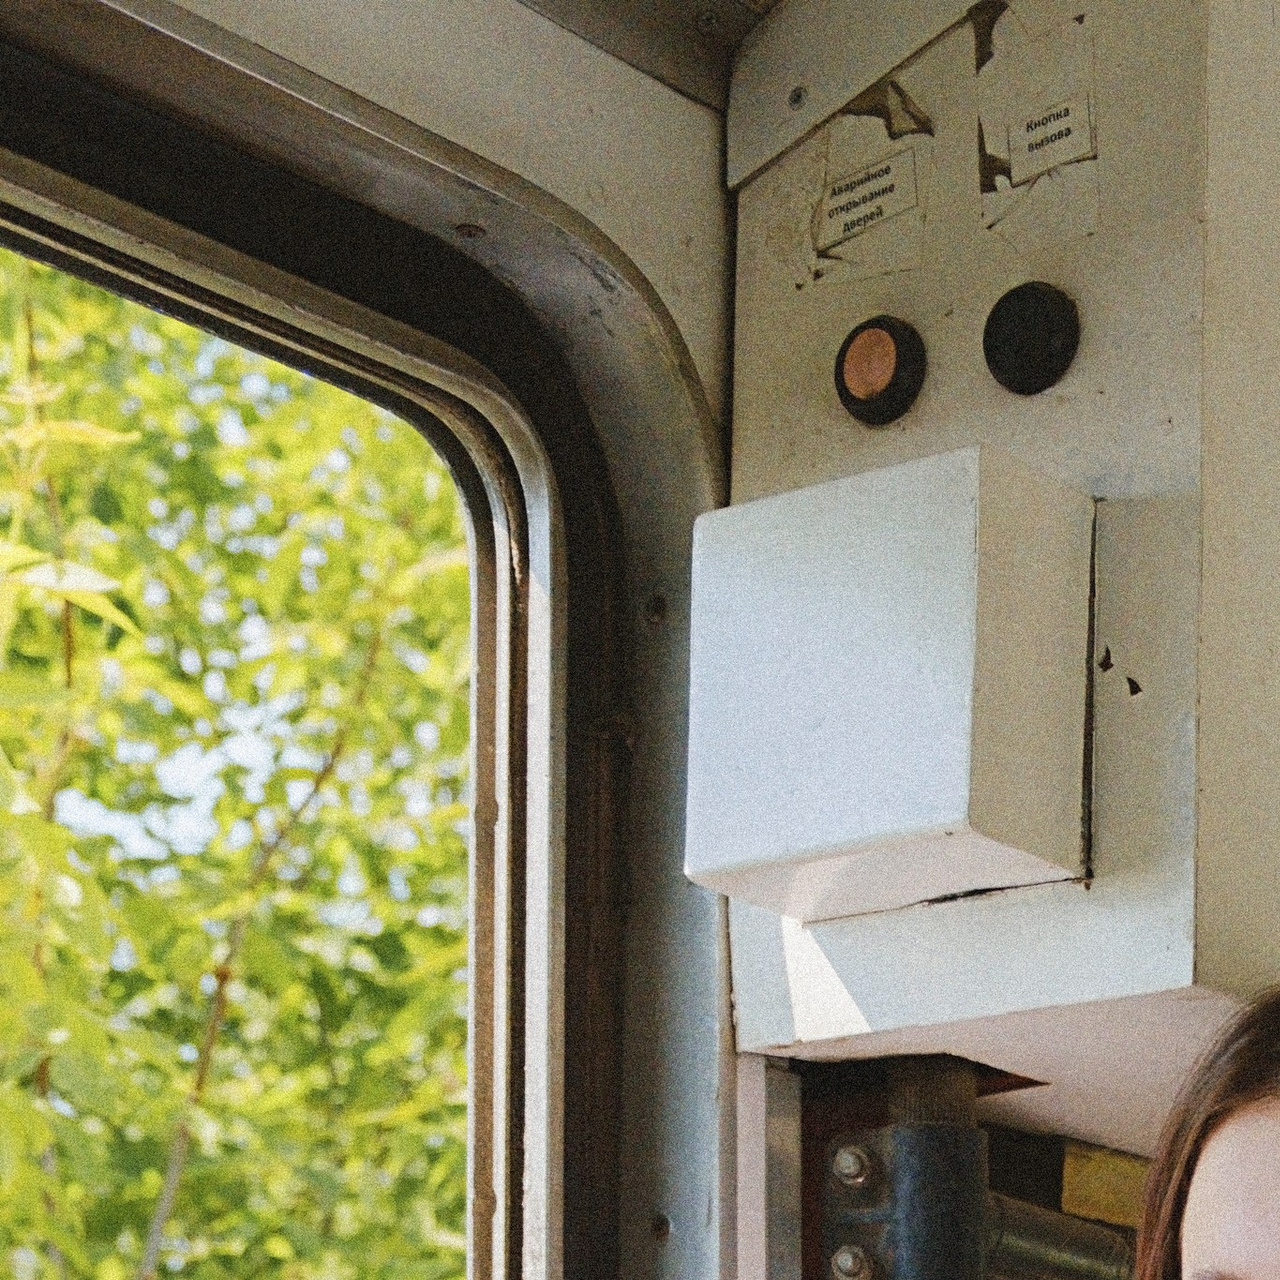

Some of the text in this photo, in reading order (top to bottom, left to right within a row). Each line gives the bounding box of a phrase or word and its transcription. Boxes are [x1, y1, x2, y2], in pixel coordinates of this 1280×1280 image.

[1026, 107, 1070, 133] Кнопка
[1027, 127, 1072, 152] вызова
[830, 165, 891, 199] Аварийное
[828, 183, 895, 219] открывание
[843, 205, 883, 233] дверей
